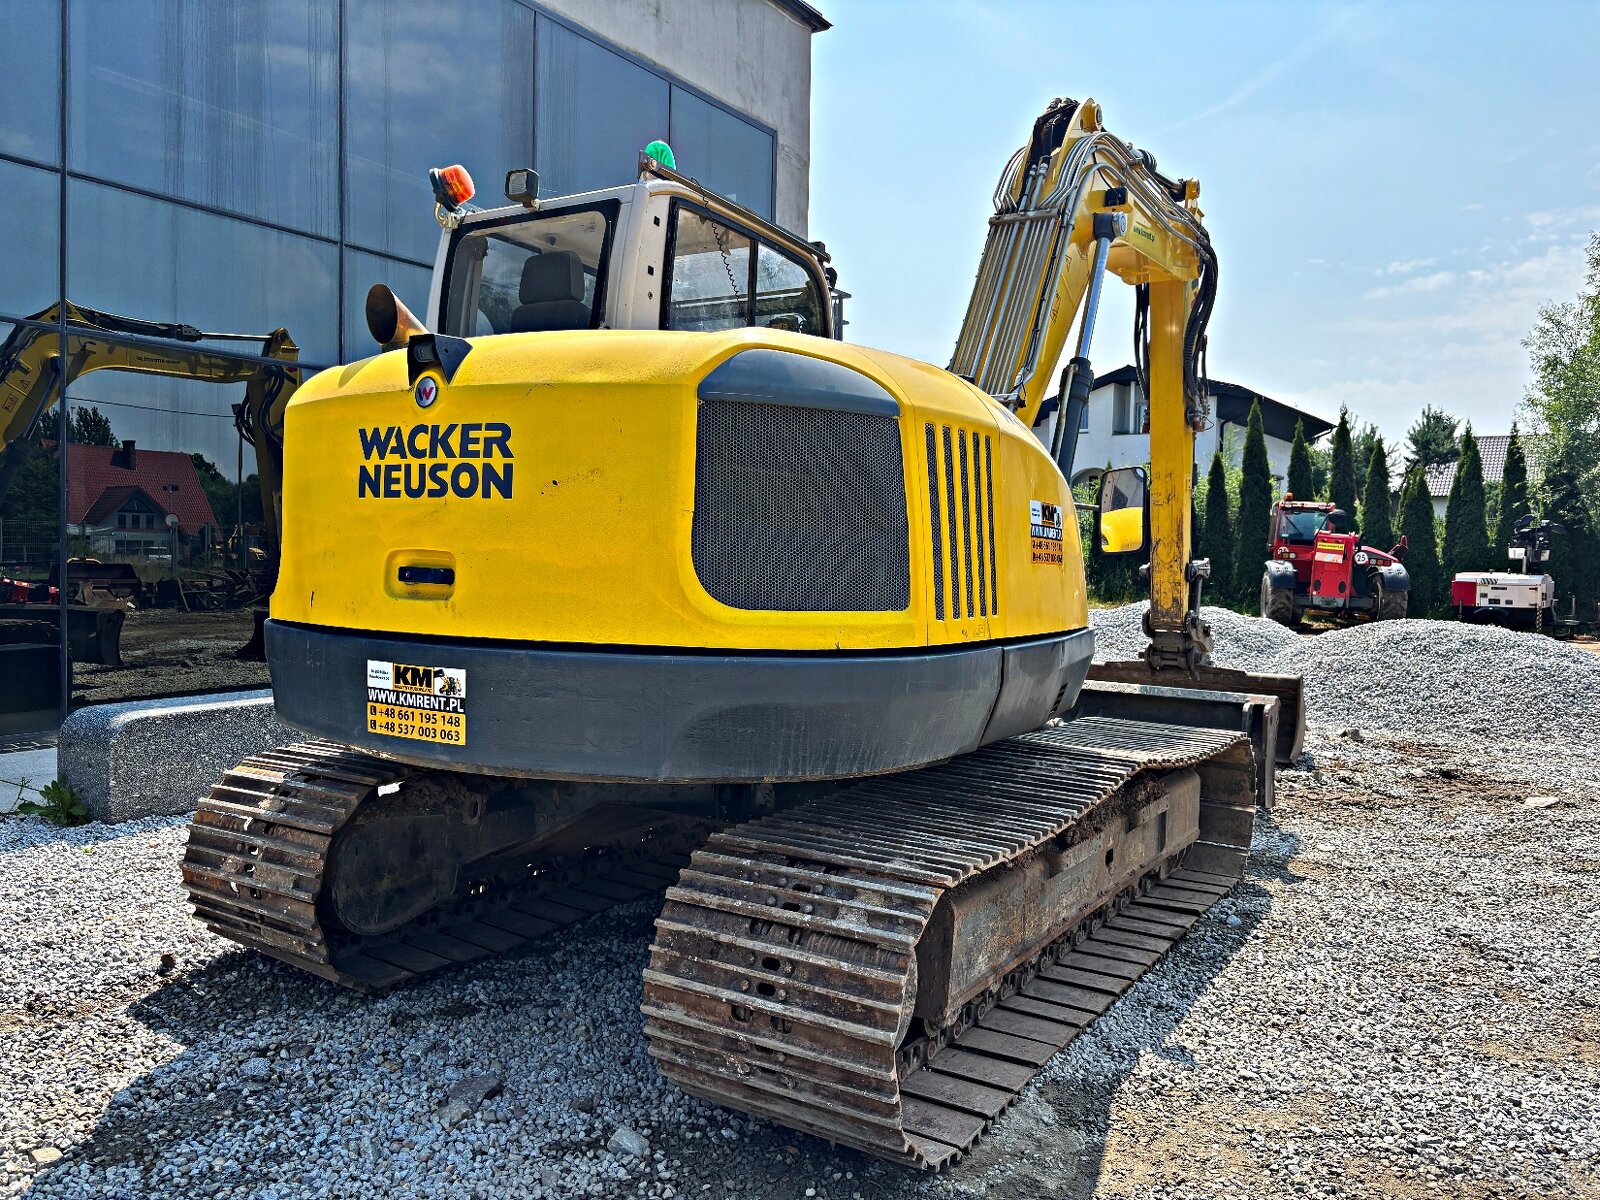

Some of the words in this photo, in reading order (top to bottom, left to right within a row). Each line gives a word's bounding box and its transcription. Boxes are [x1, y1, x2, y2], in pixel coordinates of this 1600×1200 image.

[358, 422, 515, 460] WACKER
[358, 462, 514, 499] NEUSON
[1355, 554, 1366, 562] 25
[394, 665, 433, 688] KM
[368, 688, 465, 713] WWW.KMRENT.PL
[378, 707, 396, 719] +48
[398, 709, 415, 722] 661
[419, 712, 438, 725] 195
[441, 715, 461, 727] 148
[378, 721, 396, 733] +48
[397, 723, 416, 735] 537
[418, 726, 437, 739] 003
[439, 729, 460, 742] 063
